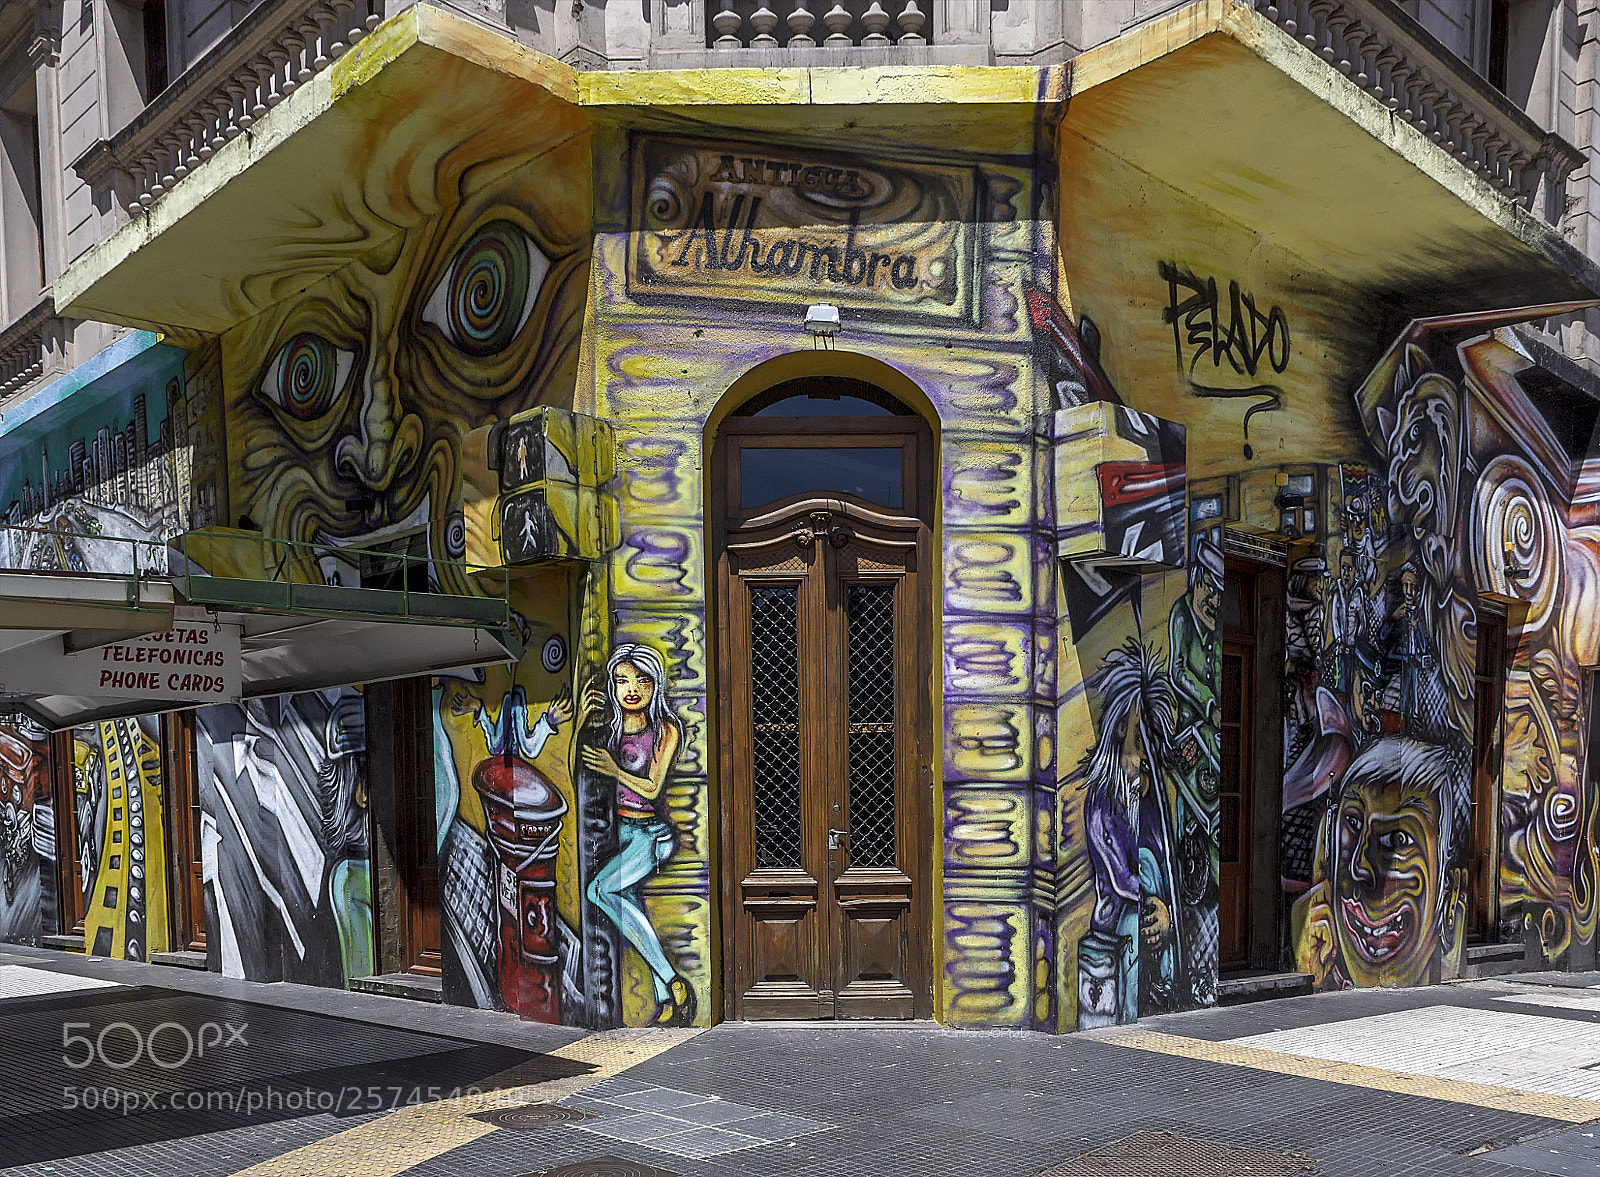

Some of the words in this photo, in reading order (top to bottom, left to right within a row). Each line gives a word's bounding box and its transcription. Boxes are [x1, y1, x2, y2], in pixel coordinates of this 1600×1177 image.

[711, 155, 868, 195] ANTIGUA
[672, 191, 919, 290] Alhambra
[102, 646, 225, 667] TELEFONICAS
[99, 670, 160, 690] PHONE
[167, 673, 225, 693] CARDS
